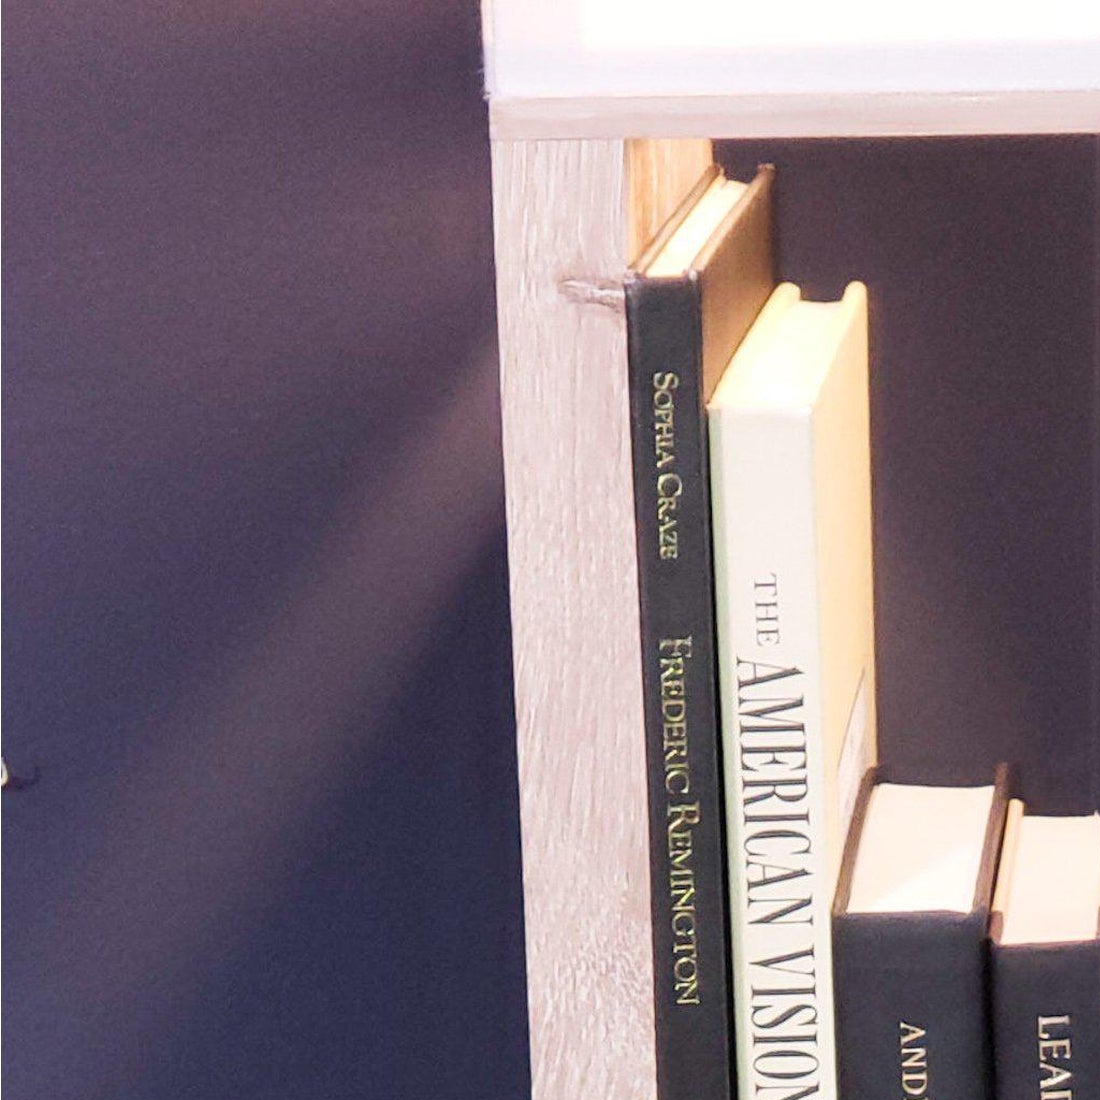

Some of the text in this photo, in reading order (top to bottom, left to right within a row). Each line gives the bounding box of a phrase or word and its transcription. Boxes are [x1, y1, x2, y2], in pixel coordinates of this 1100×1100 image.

[653, 371, 682, 560] SOPHIA CRAZE
[754, 573, 780, 647] THE
[659, 636, 701, 1005] FREDERIC REMINGTON
[736, 656, 814, 926] AMERICAN
